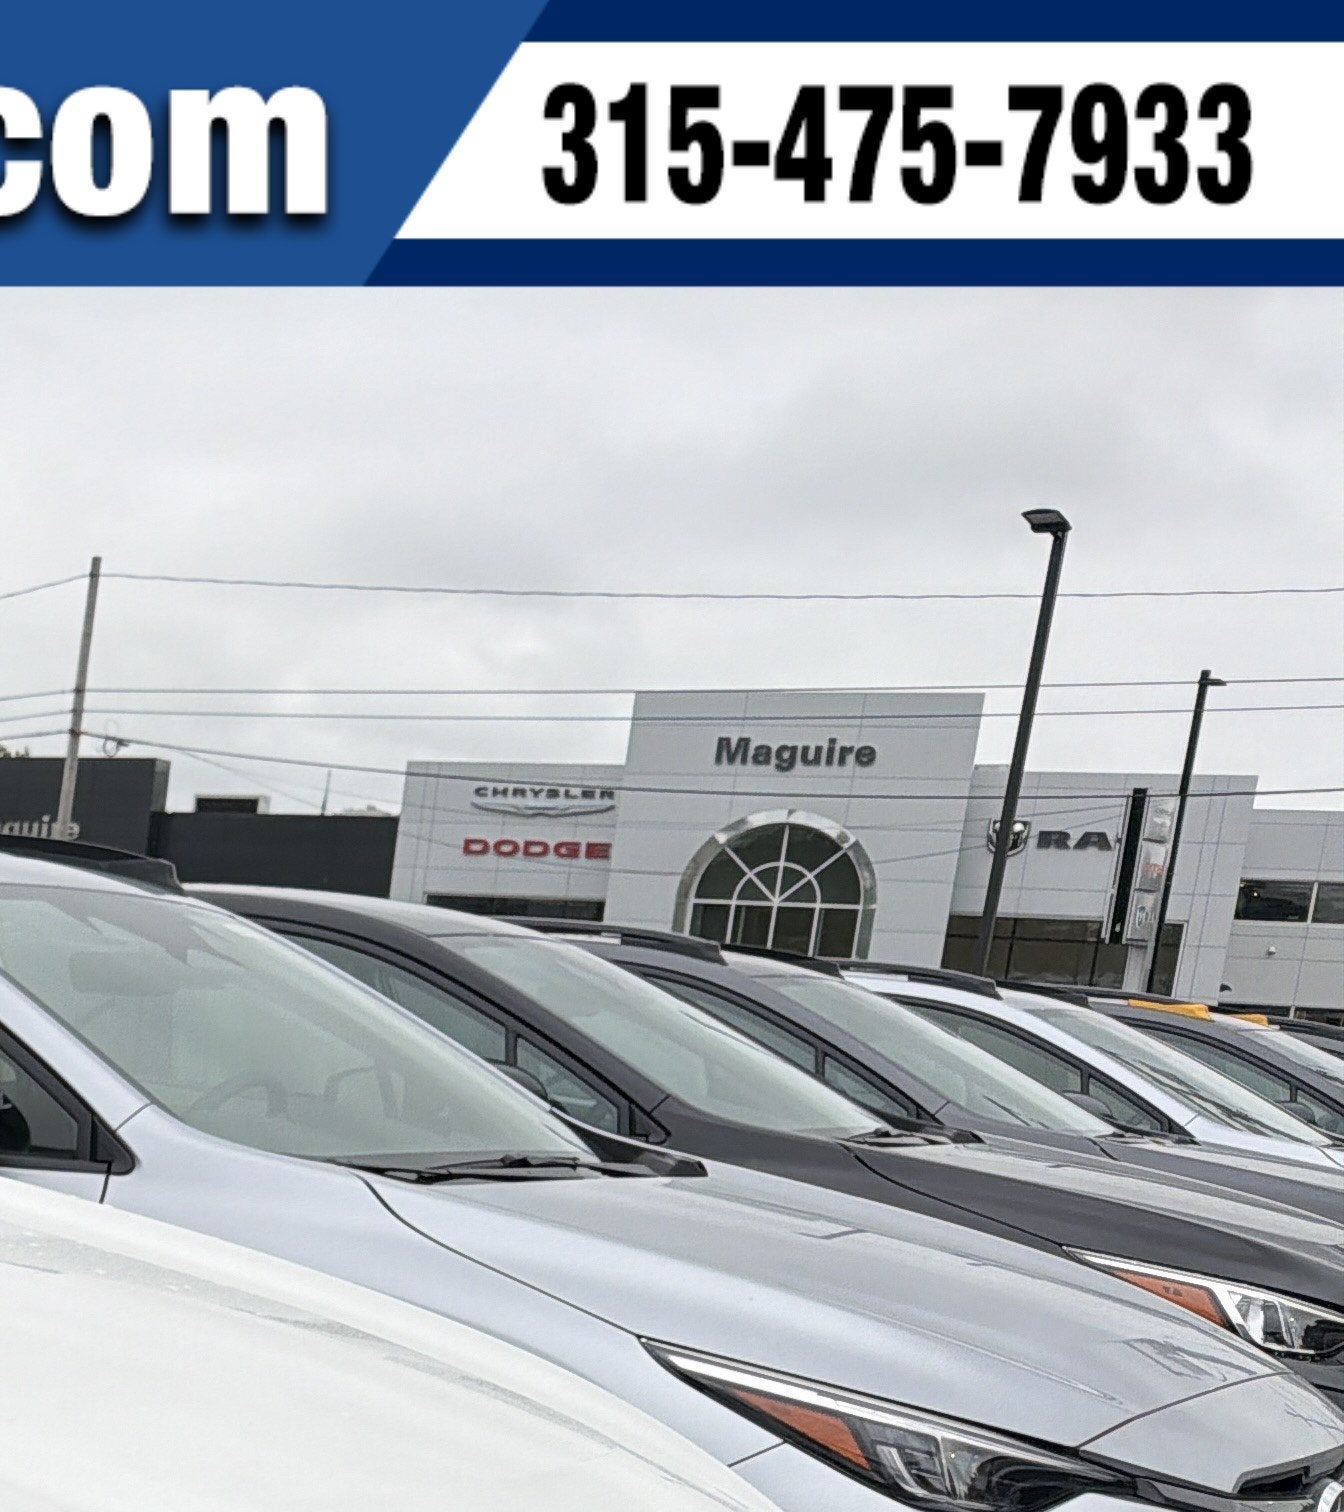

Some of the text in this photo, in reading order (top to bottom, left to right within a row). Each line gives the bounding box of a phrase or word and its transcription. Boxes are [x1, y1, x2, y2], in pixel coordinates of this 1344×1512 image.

[714, 736, 877, 773] Maguire
[474, 786, 615, 800] CHRYSLER
[463, 838, 612, 859] DODGE
[1037, 830, 1113, 851] RA
